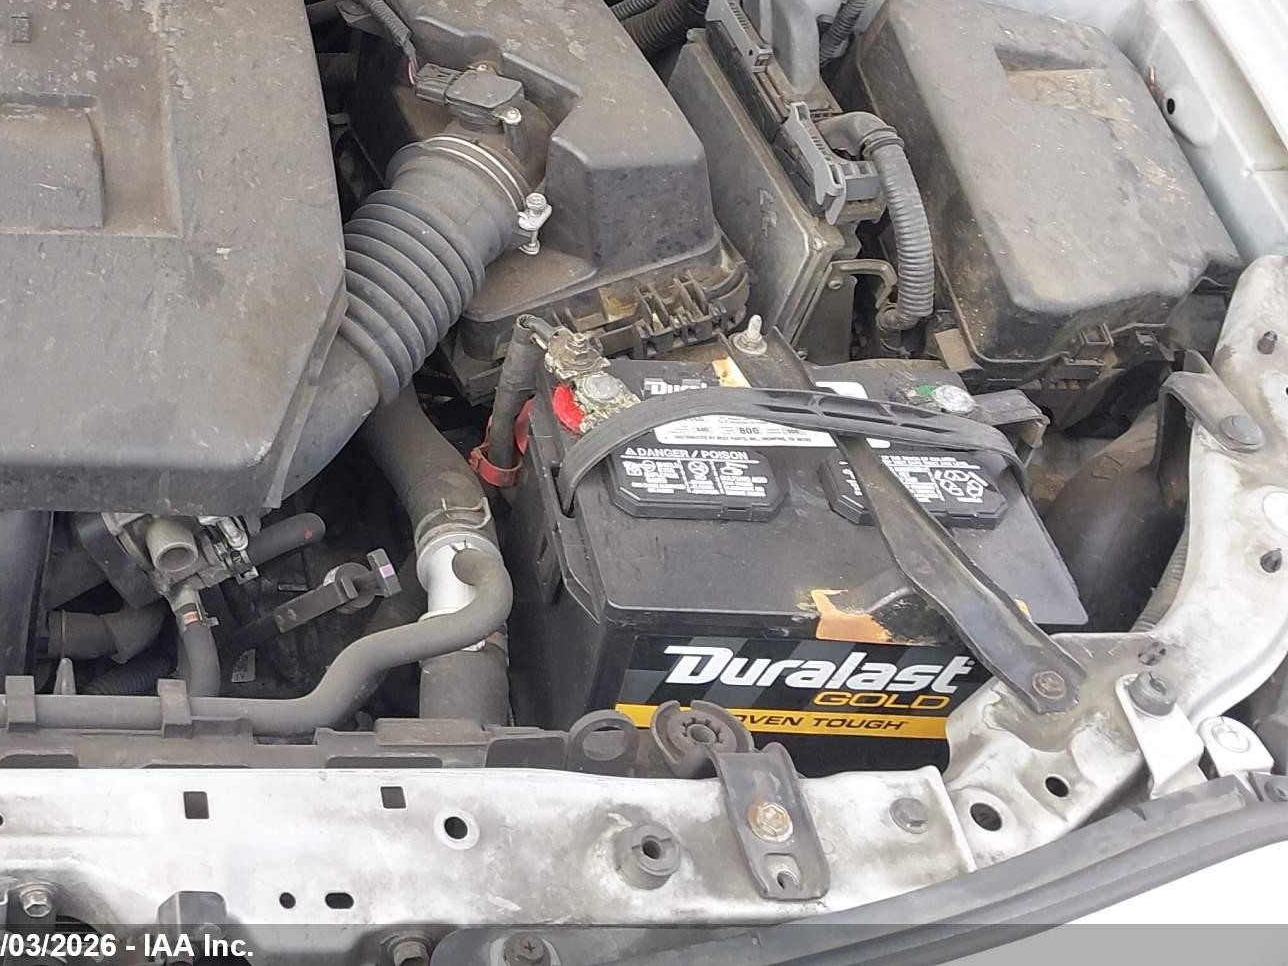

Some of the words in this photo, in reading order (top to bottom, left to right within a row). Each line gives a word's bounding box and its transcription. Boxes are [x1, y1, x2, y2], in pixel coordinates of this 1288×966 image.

[738, 427, 760, 435] 800
[637, 447, 689, 458] DANGER
[700, 449, 749, 460] POISON
[664, 645, 972, 693] Duralast
[813, 691, 949, 710] GOLD
[813, 718, 906, 731] TOUGH
